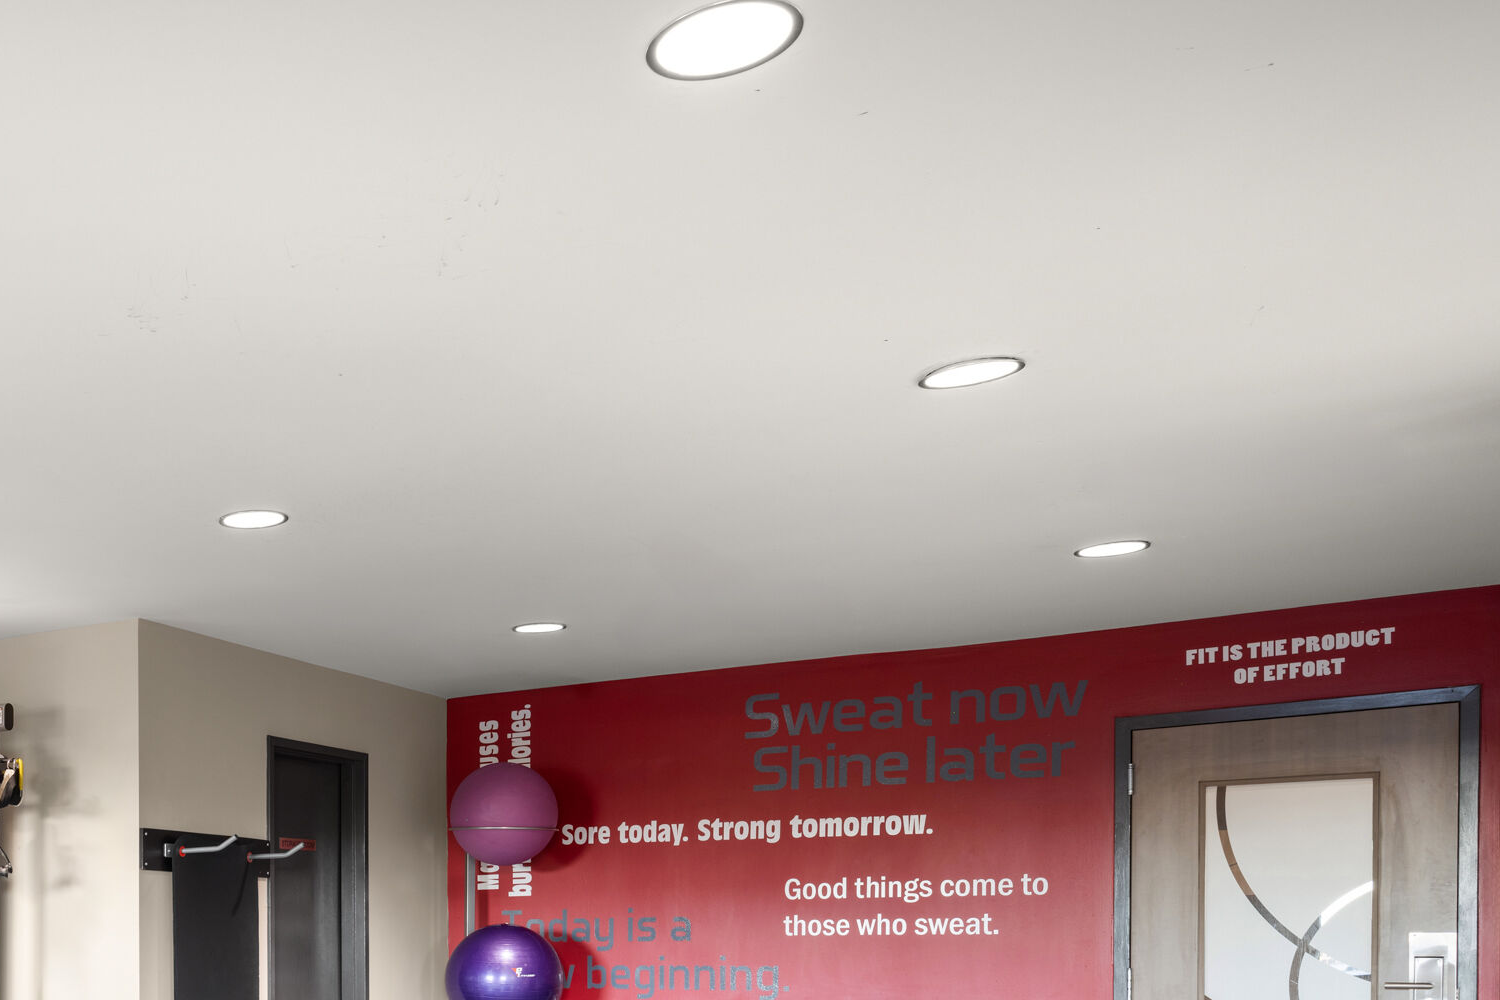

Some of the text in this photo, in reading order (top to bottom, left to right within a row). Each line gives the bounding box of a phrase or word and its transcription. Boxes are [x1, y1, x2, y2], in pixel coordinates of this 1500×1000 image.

[1185, 626, 1396, 666] FIT IS THE PRODUCT
[1233, 657, 1346, 685] OF EFFORT
[744, 679, 1090, 740] Sweat now
[752, 732, 1077, 792] Shine later
[561, 813, 934, 846] Sore today. Strong tomorrow.
[784, 873, 1049, 903] Good things come to
[627, 907, 657, 942] is
[670, 916, 692, 942] a
[783, 913, 1000, 937] those who sweat.
[587, 955, 790, 1000] beginning.
